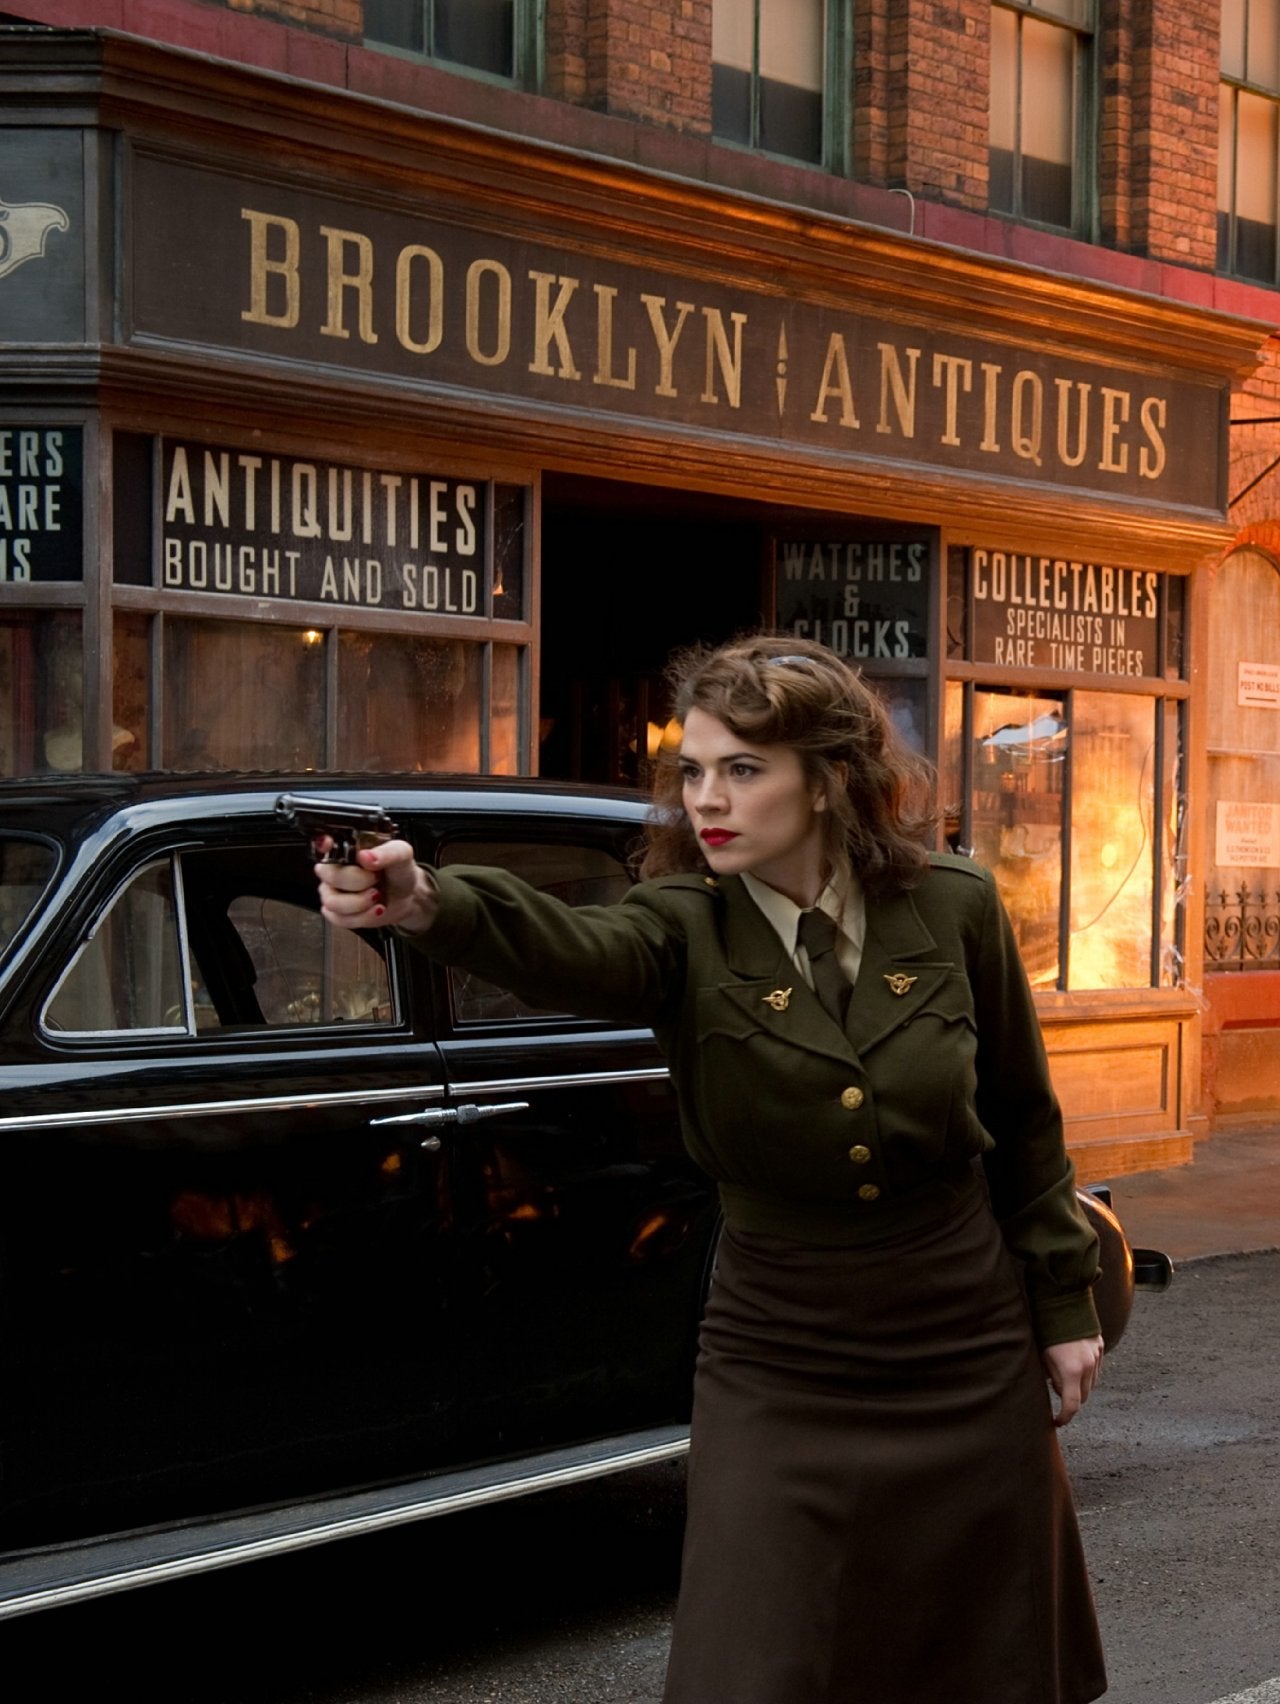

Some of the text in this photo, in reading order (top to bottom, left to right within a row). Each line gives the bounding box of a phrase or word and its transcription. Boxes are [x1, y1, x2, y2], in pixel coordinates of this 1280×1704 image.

[240, 207, 1168, 480] BROOKLYN ANTIQUES
[165, 446, 476, 557] ANTIQUITIES
[165, 538, 476, 613] BOUGHT AND SOLD
[783, 542, 923, 582] WATCHES
[973, 549, 1158, 619] COLLECTABLES
[843, 584, 861, 618] &
[1006, 607, 1126, 647] SPECIALISTS IN
[995, 636, 1144, 677] RARE TIME PIECES
